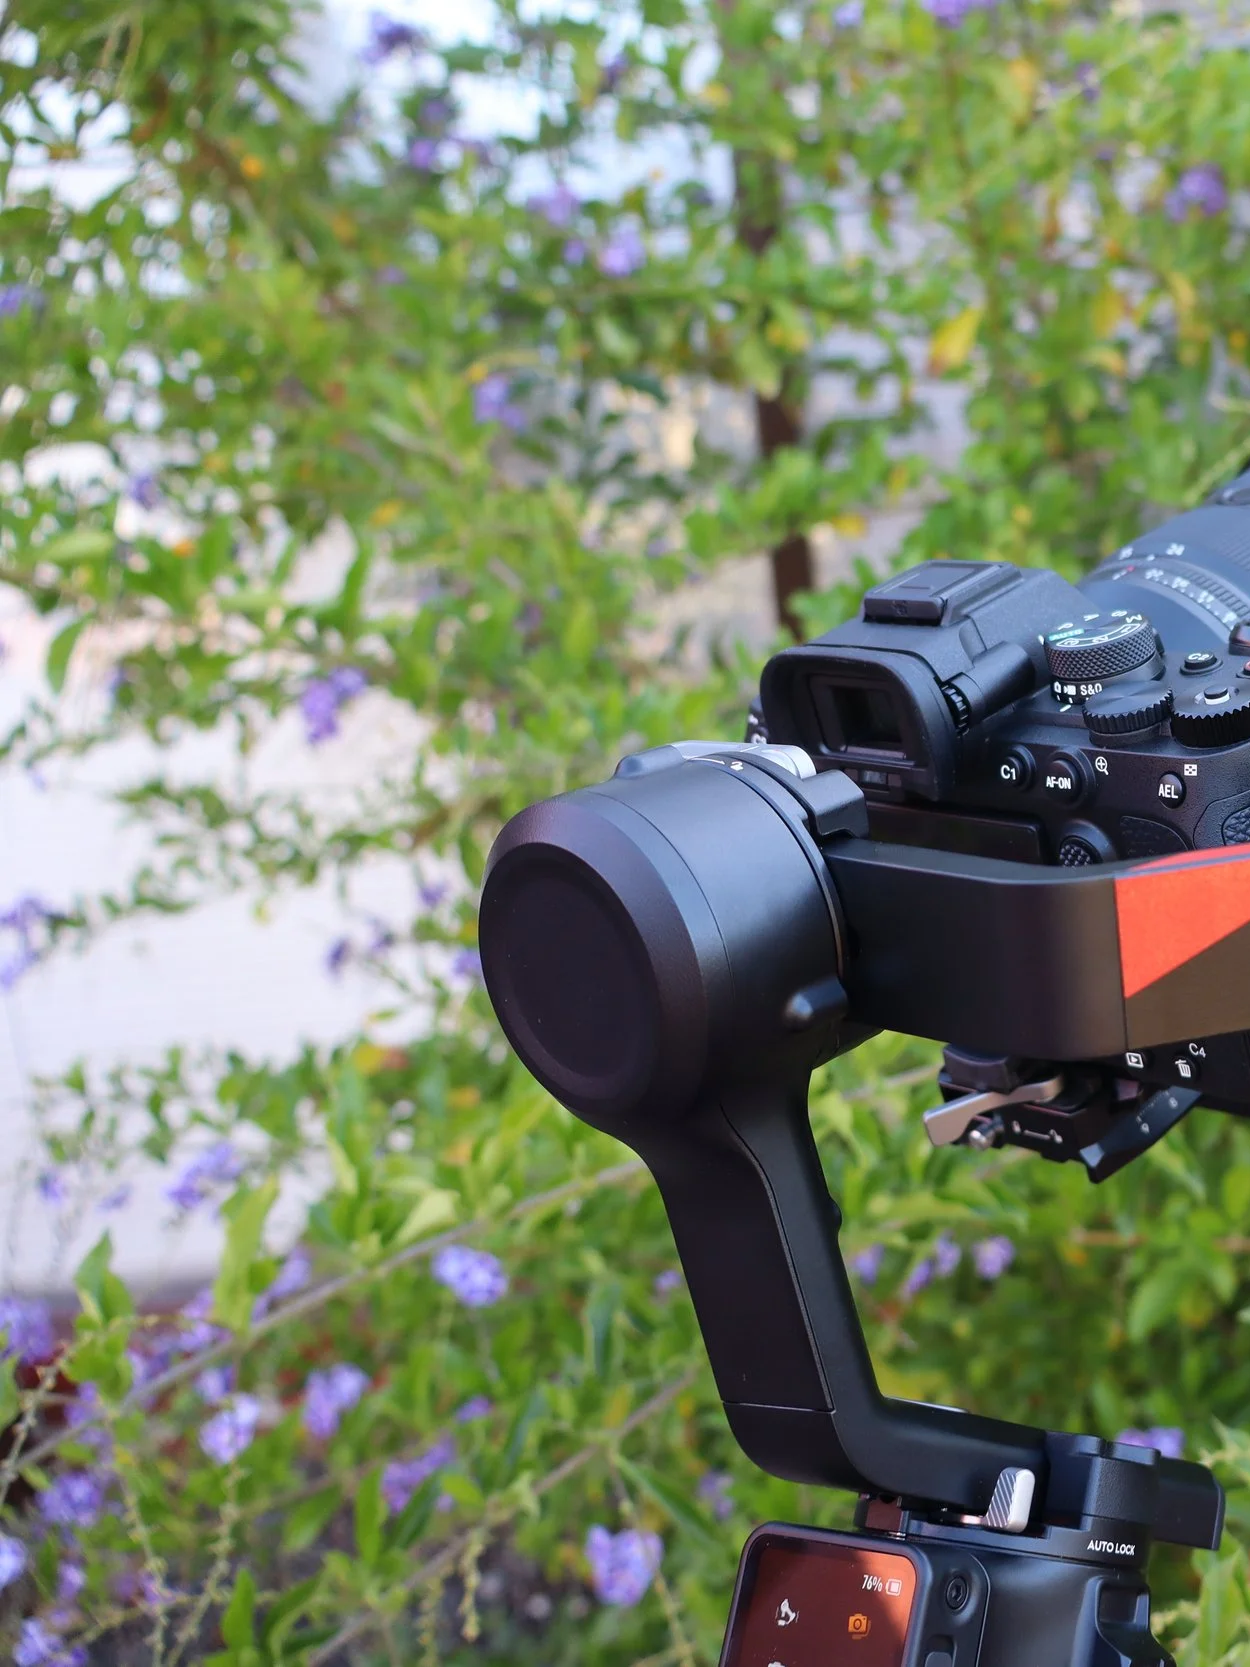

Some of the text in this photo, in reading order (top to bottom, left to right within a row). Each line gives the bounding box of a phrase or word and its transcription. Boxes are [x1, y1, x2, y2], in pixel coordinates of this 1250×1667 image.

[1187, 652, 1211, 661] C2
[1000, 765, 1016, 780] C1
[1046, 776, 1072, 790] AF-ON
[1158, 783, 1179, 799] AEL
[1188, 1042, 1207, 1059] C4
[1087, 1539, 1136, 1556] AUTO LOCK
[861, 1574, 883, 1592] 76%
